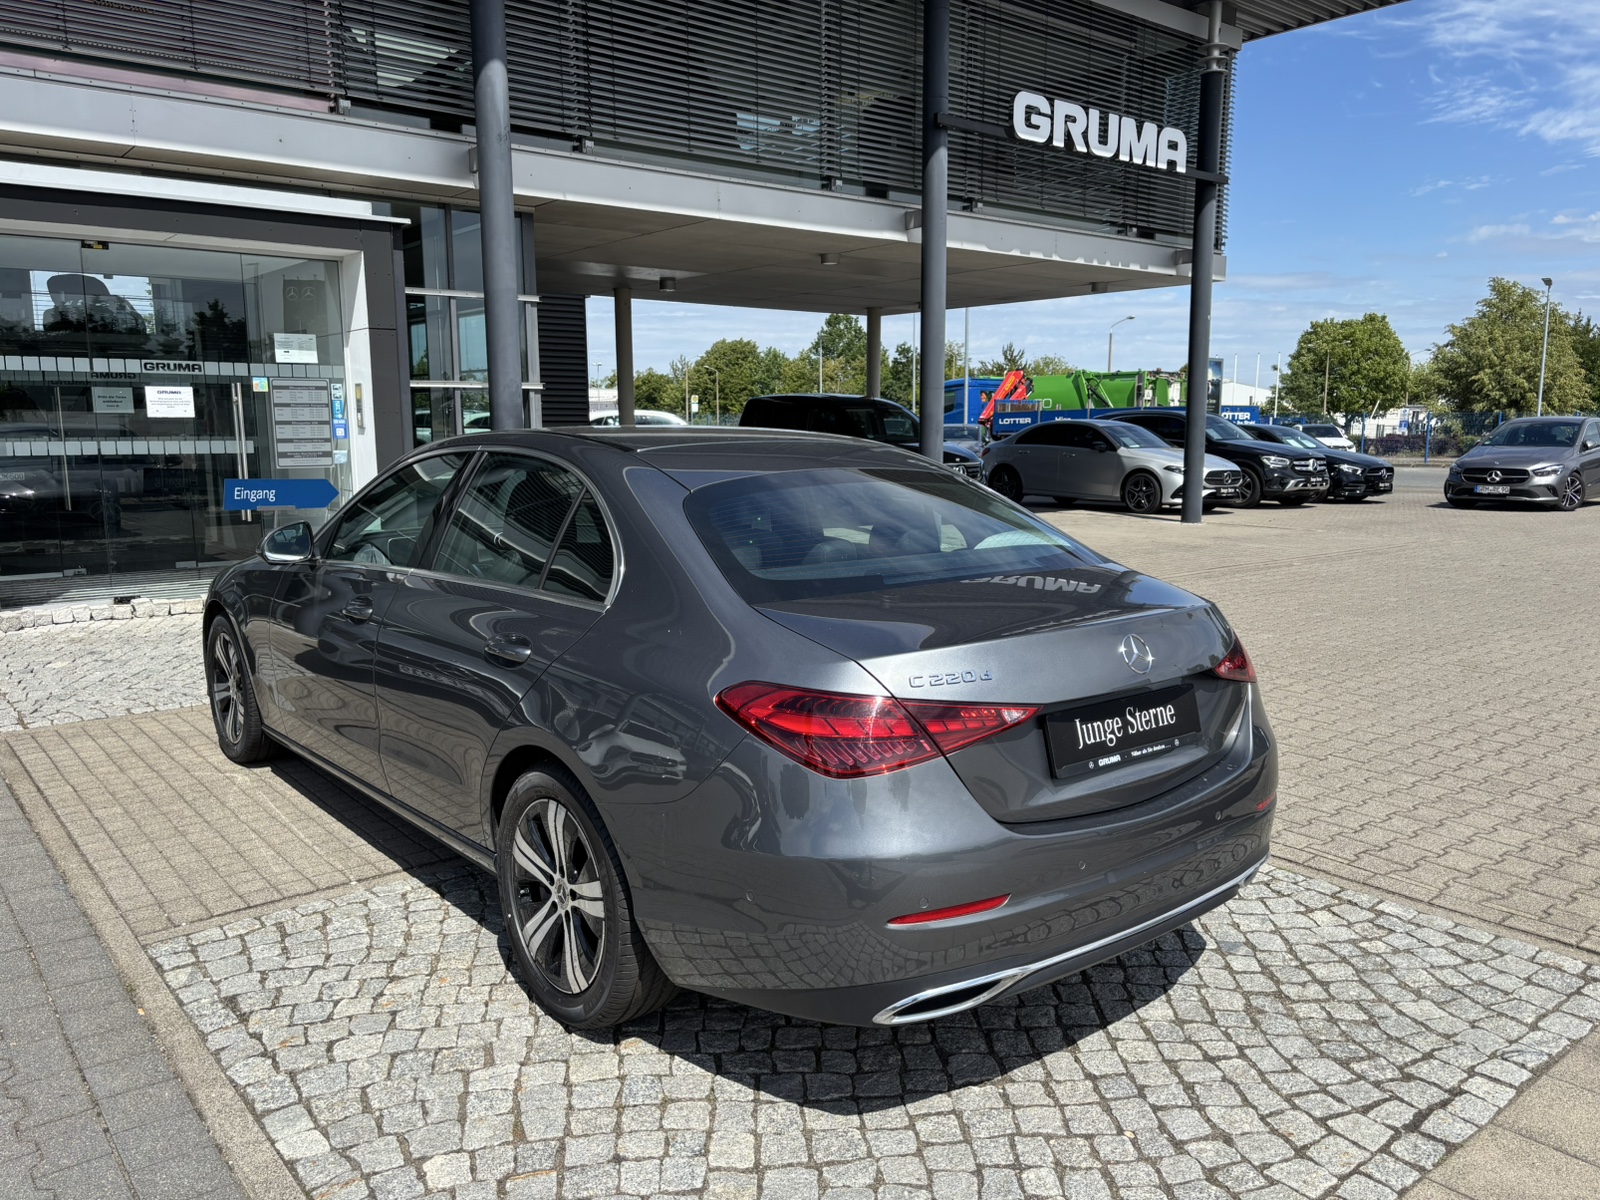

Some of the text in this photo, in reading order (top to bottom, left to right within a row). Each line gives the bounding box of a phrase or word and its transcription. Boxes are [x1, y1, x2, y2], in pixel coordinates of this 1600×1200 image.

[1013, 91, 1187, 174] GRUMA
[143, 362, 203, 373] GRUMA
[998, 417, 1032, 425] LOTTER
[1221, 412, 1251, 420] OTTER
[234, 486, 276, 503] Eingang
[908, 669, 993, 689] C 220 d
[1074, 703, 1176, 750] Junge Sterne
[1098, 754, 1121, 767] GRUMA
